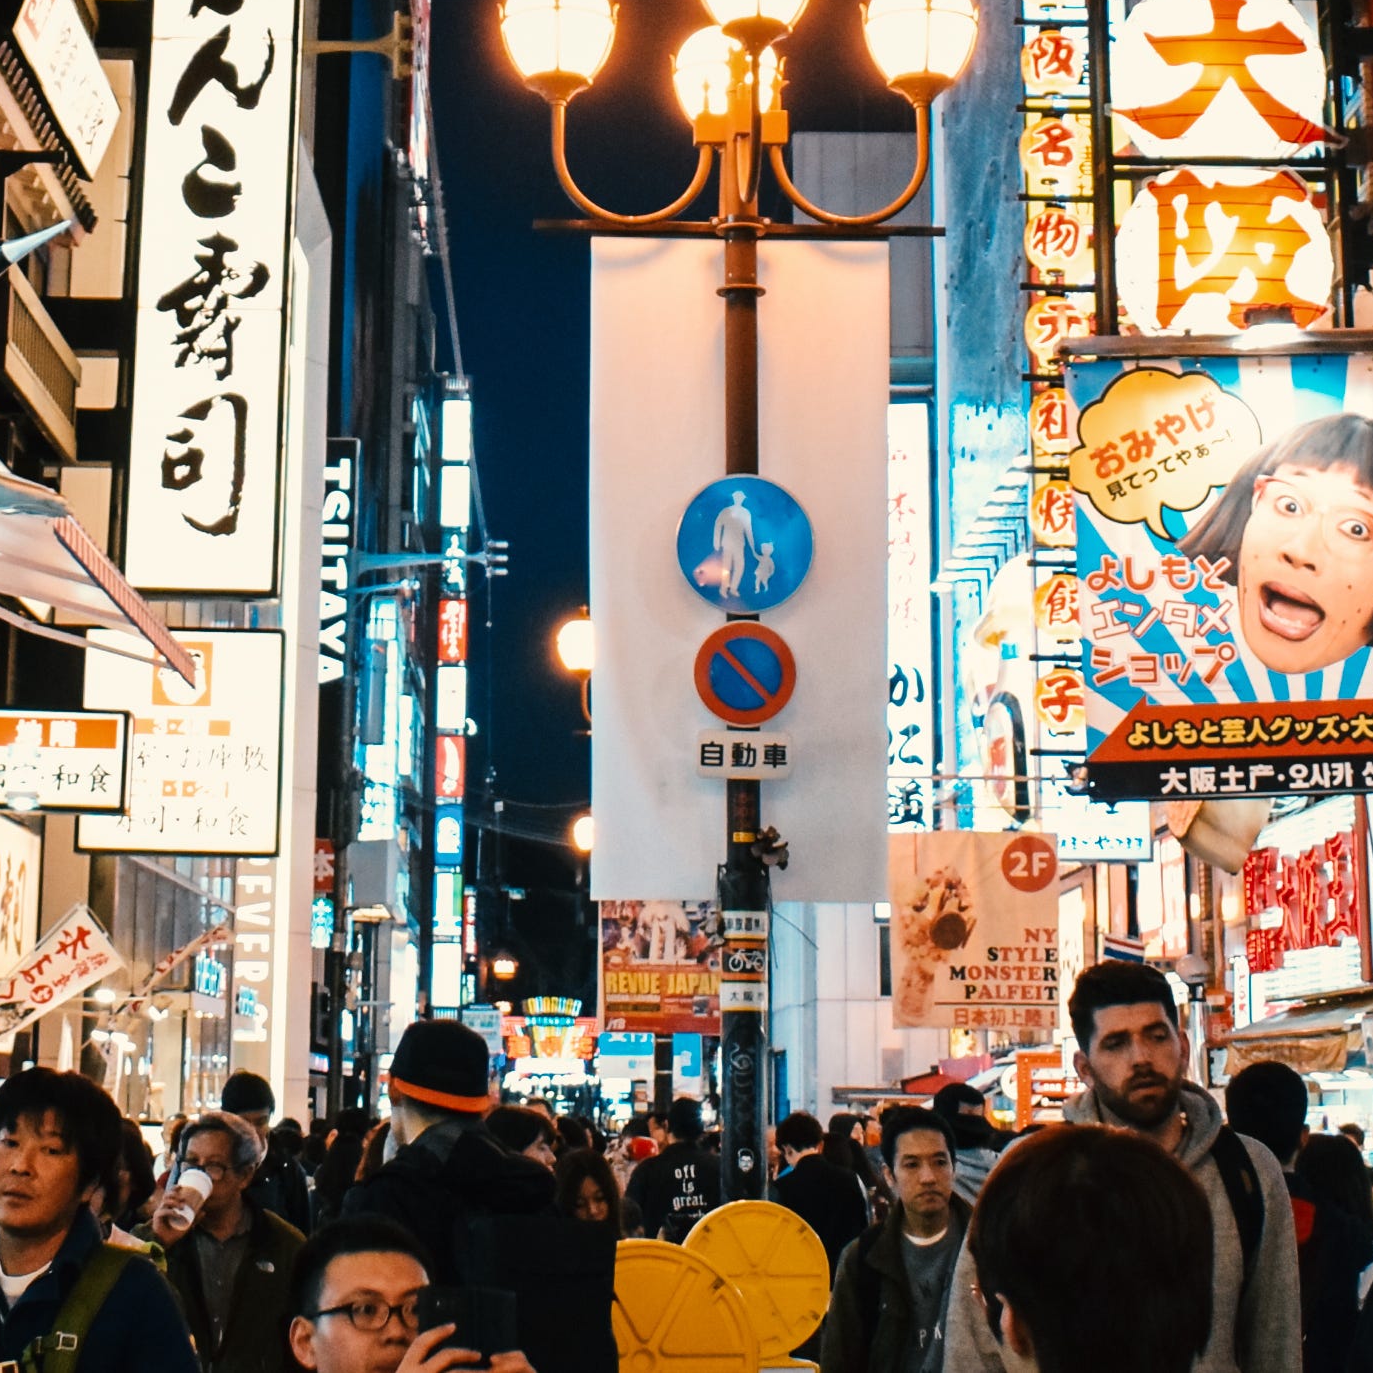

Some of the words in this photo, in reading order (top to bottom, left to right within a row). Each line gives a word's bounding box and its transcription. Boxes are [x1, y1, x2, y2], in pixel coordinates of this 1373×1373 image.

[1090, 392, 1217, 480] おみやげ
[319, 458, 353, 684] TSUTAYA
[1087, 554, 1232, 591] よしもと
[1089, 597, 1234, 640] エンタメ
[1091, 643, 1236, 686] ショップ
[700, 741, 788, 769] 自動車
[1009, 851, 1049, 877] 2F
[1024, 928, 1057, 943] NY
[988, 947, 1058, 962] STYLE
[605, 972, 661, 995] REVUE
[949, 966, 1058, 981] MONSTER
[965, 985, 1058, 1000] PALFEIT
[674, 1164, 696, 1179] off
[682, 1180, 695, 1193] is
